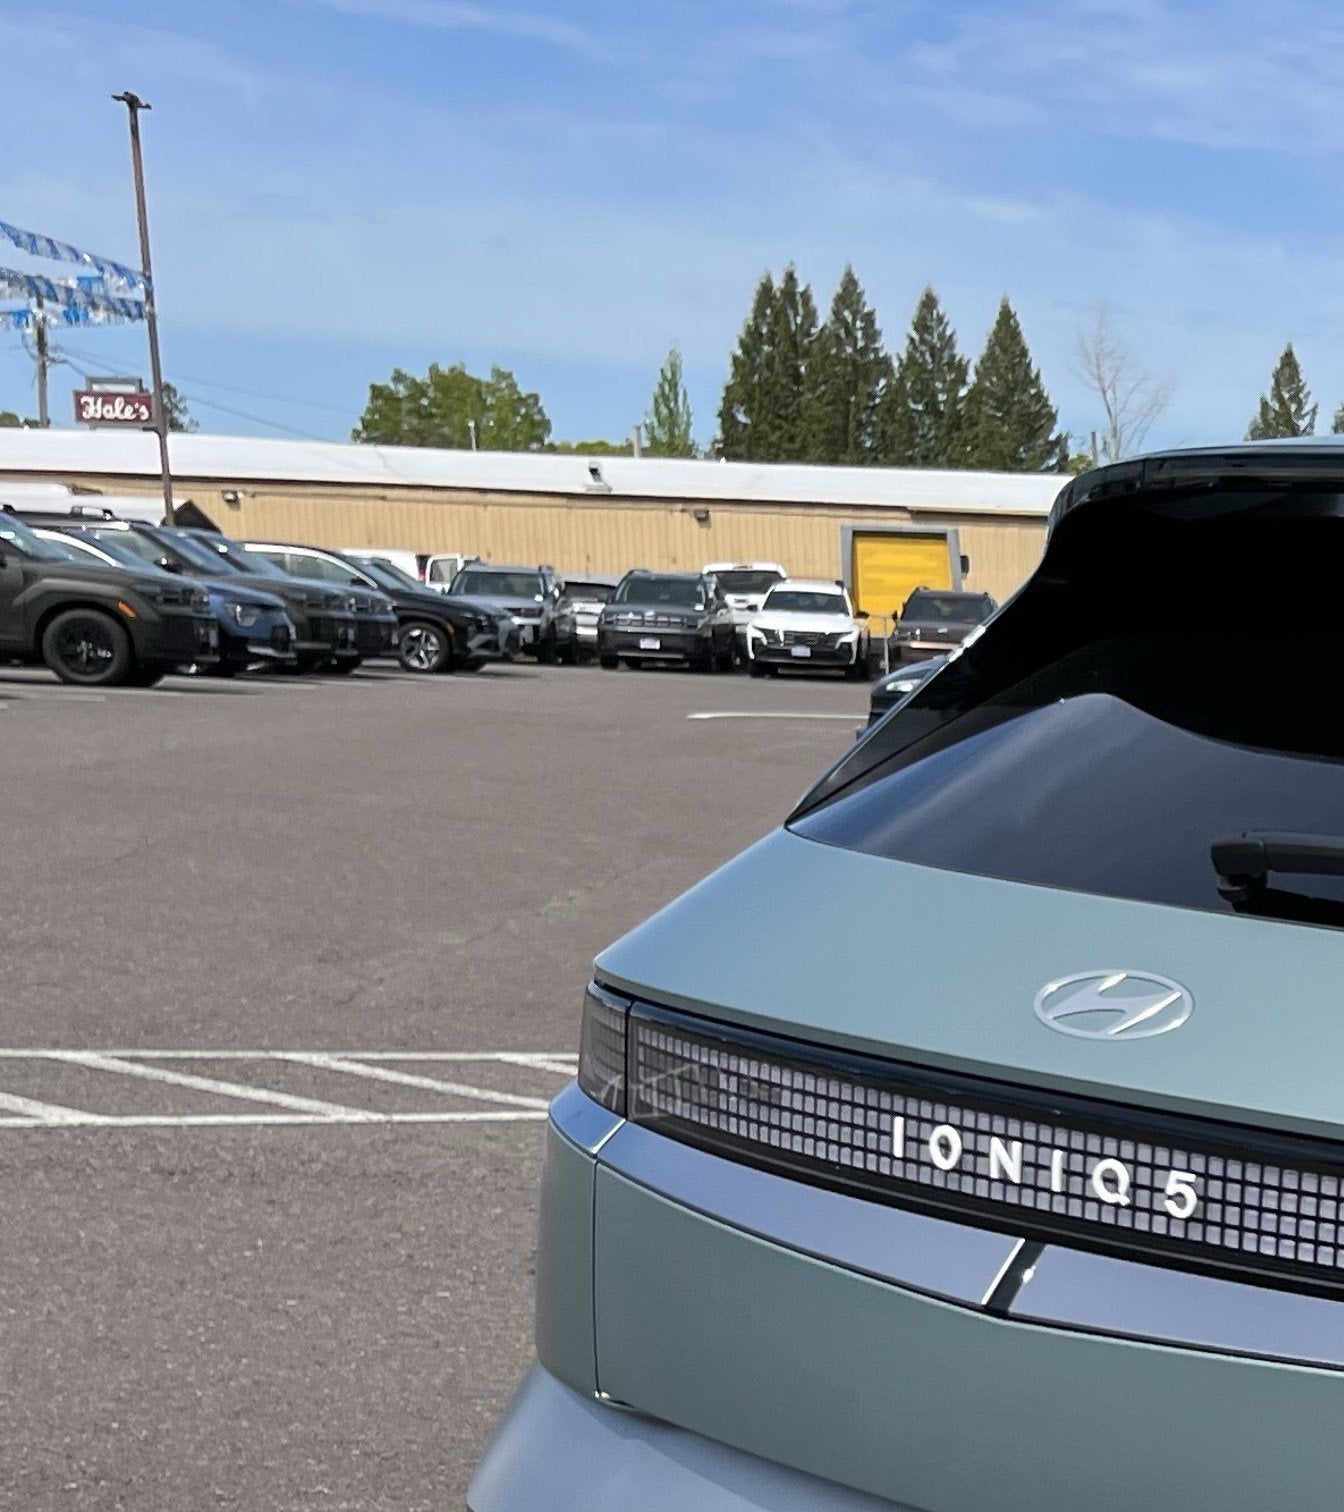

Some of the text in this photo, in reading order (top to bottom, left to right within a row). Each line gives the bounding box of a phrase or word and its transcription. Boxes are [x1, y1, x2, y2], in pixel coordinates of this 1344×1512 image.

[79, 395, 150, 421] Hale's
[891, 1116, 1199, 1219] IONIQ 5
